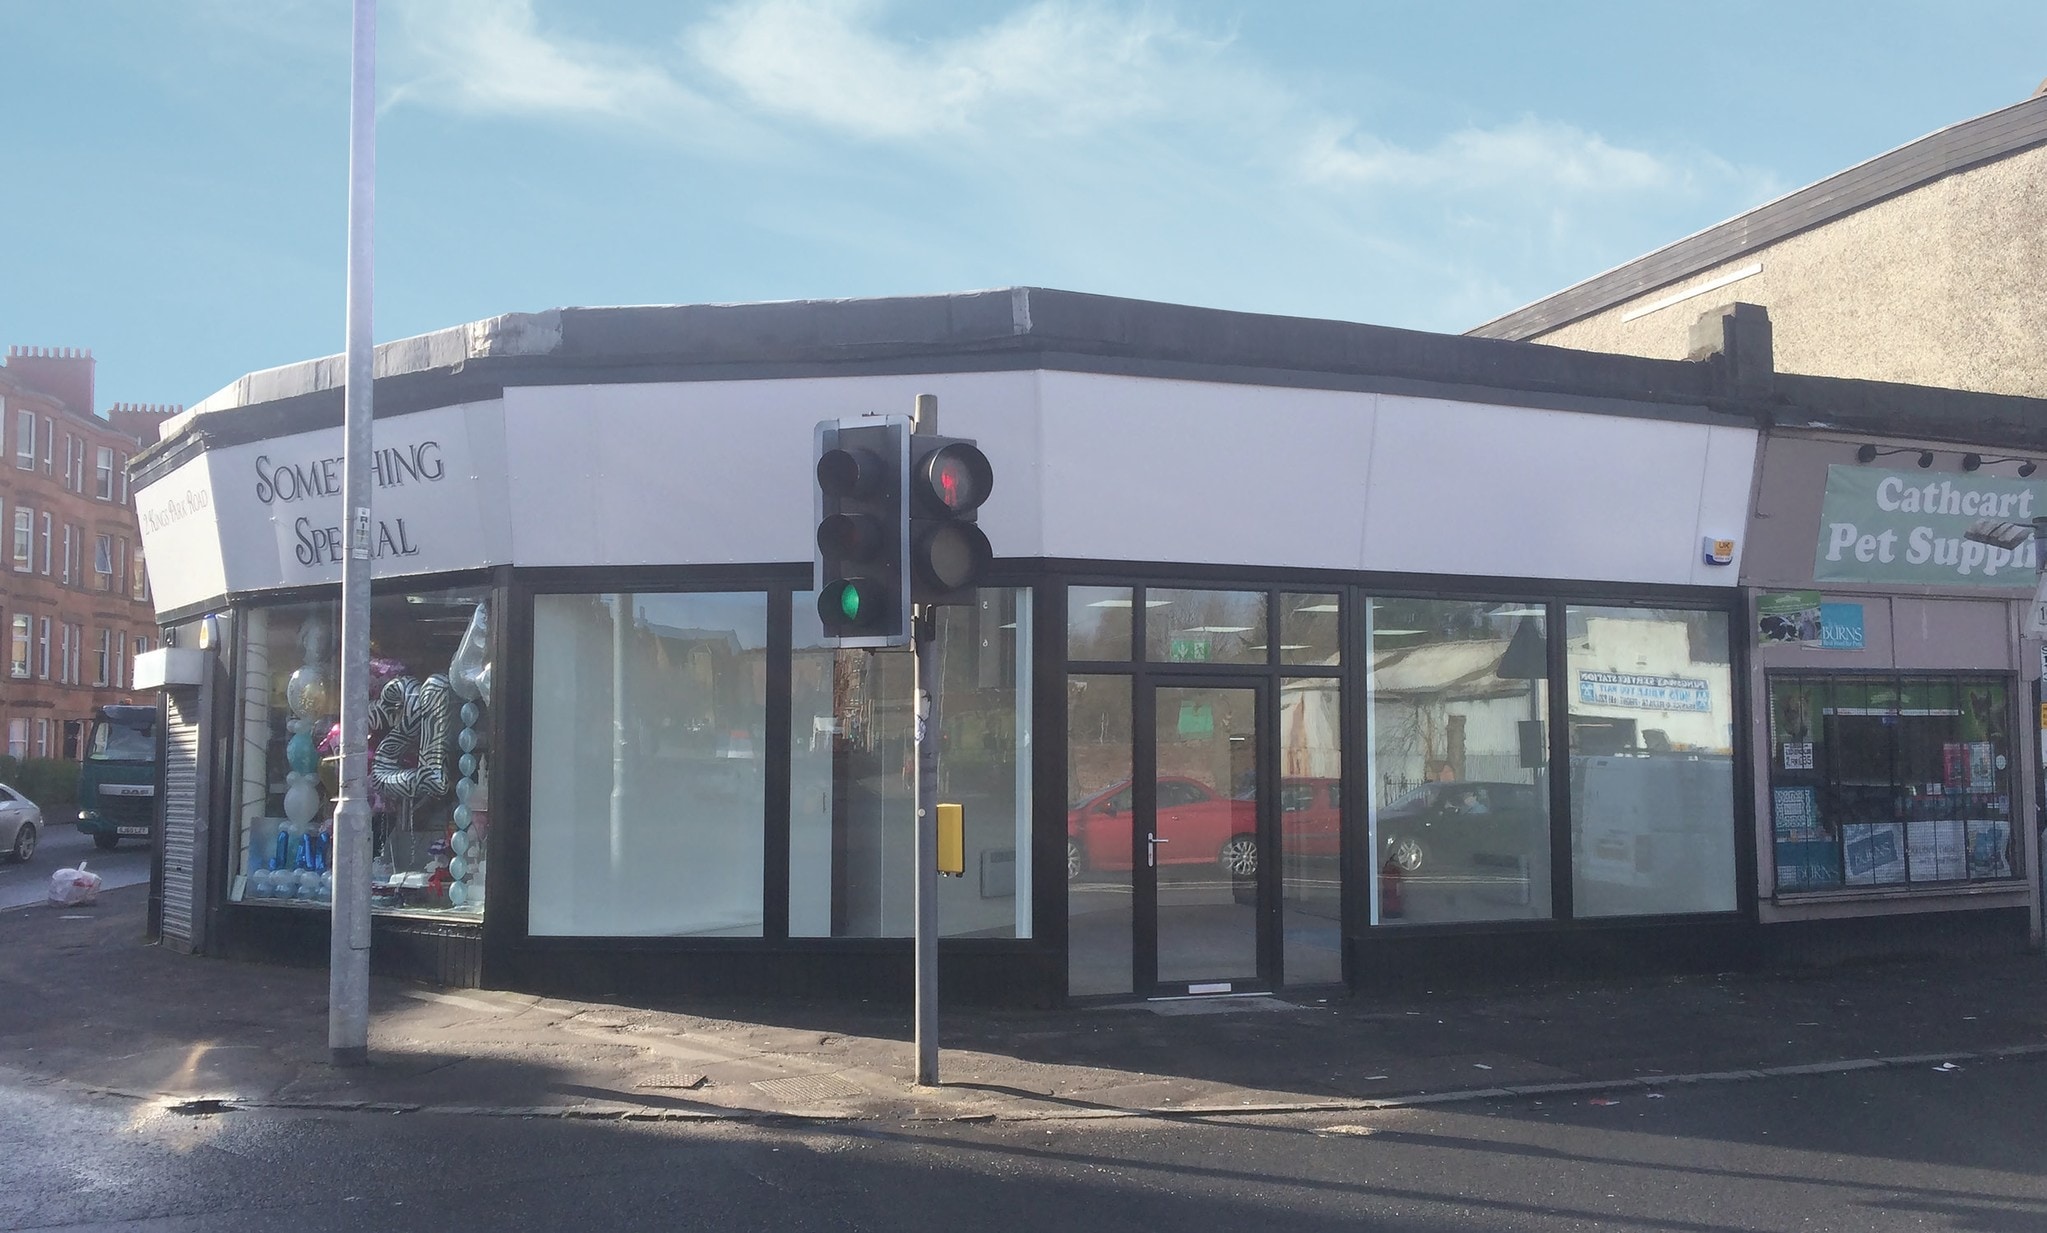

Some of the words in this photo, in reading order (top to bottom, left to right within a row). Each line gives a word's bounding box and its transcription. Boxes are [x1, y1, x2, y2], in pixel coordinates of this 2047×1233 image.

[256, 441, 445, 504] SOMEHING
[143, 513, 150, 535] 2
[168, 499, 187, 522] PARK
[186, 489, 208, 515] ROAD
[1876, 476, 2035, 518] Cathcart
[295, 517, 419, 567] SPEAL
[1825, 522, 1898, 564] Pet
[1822, 626, 1863, 641] BURNS
